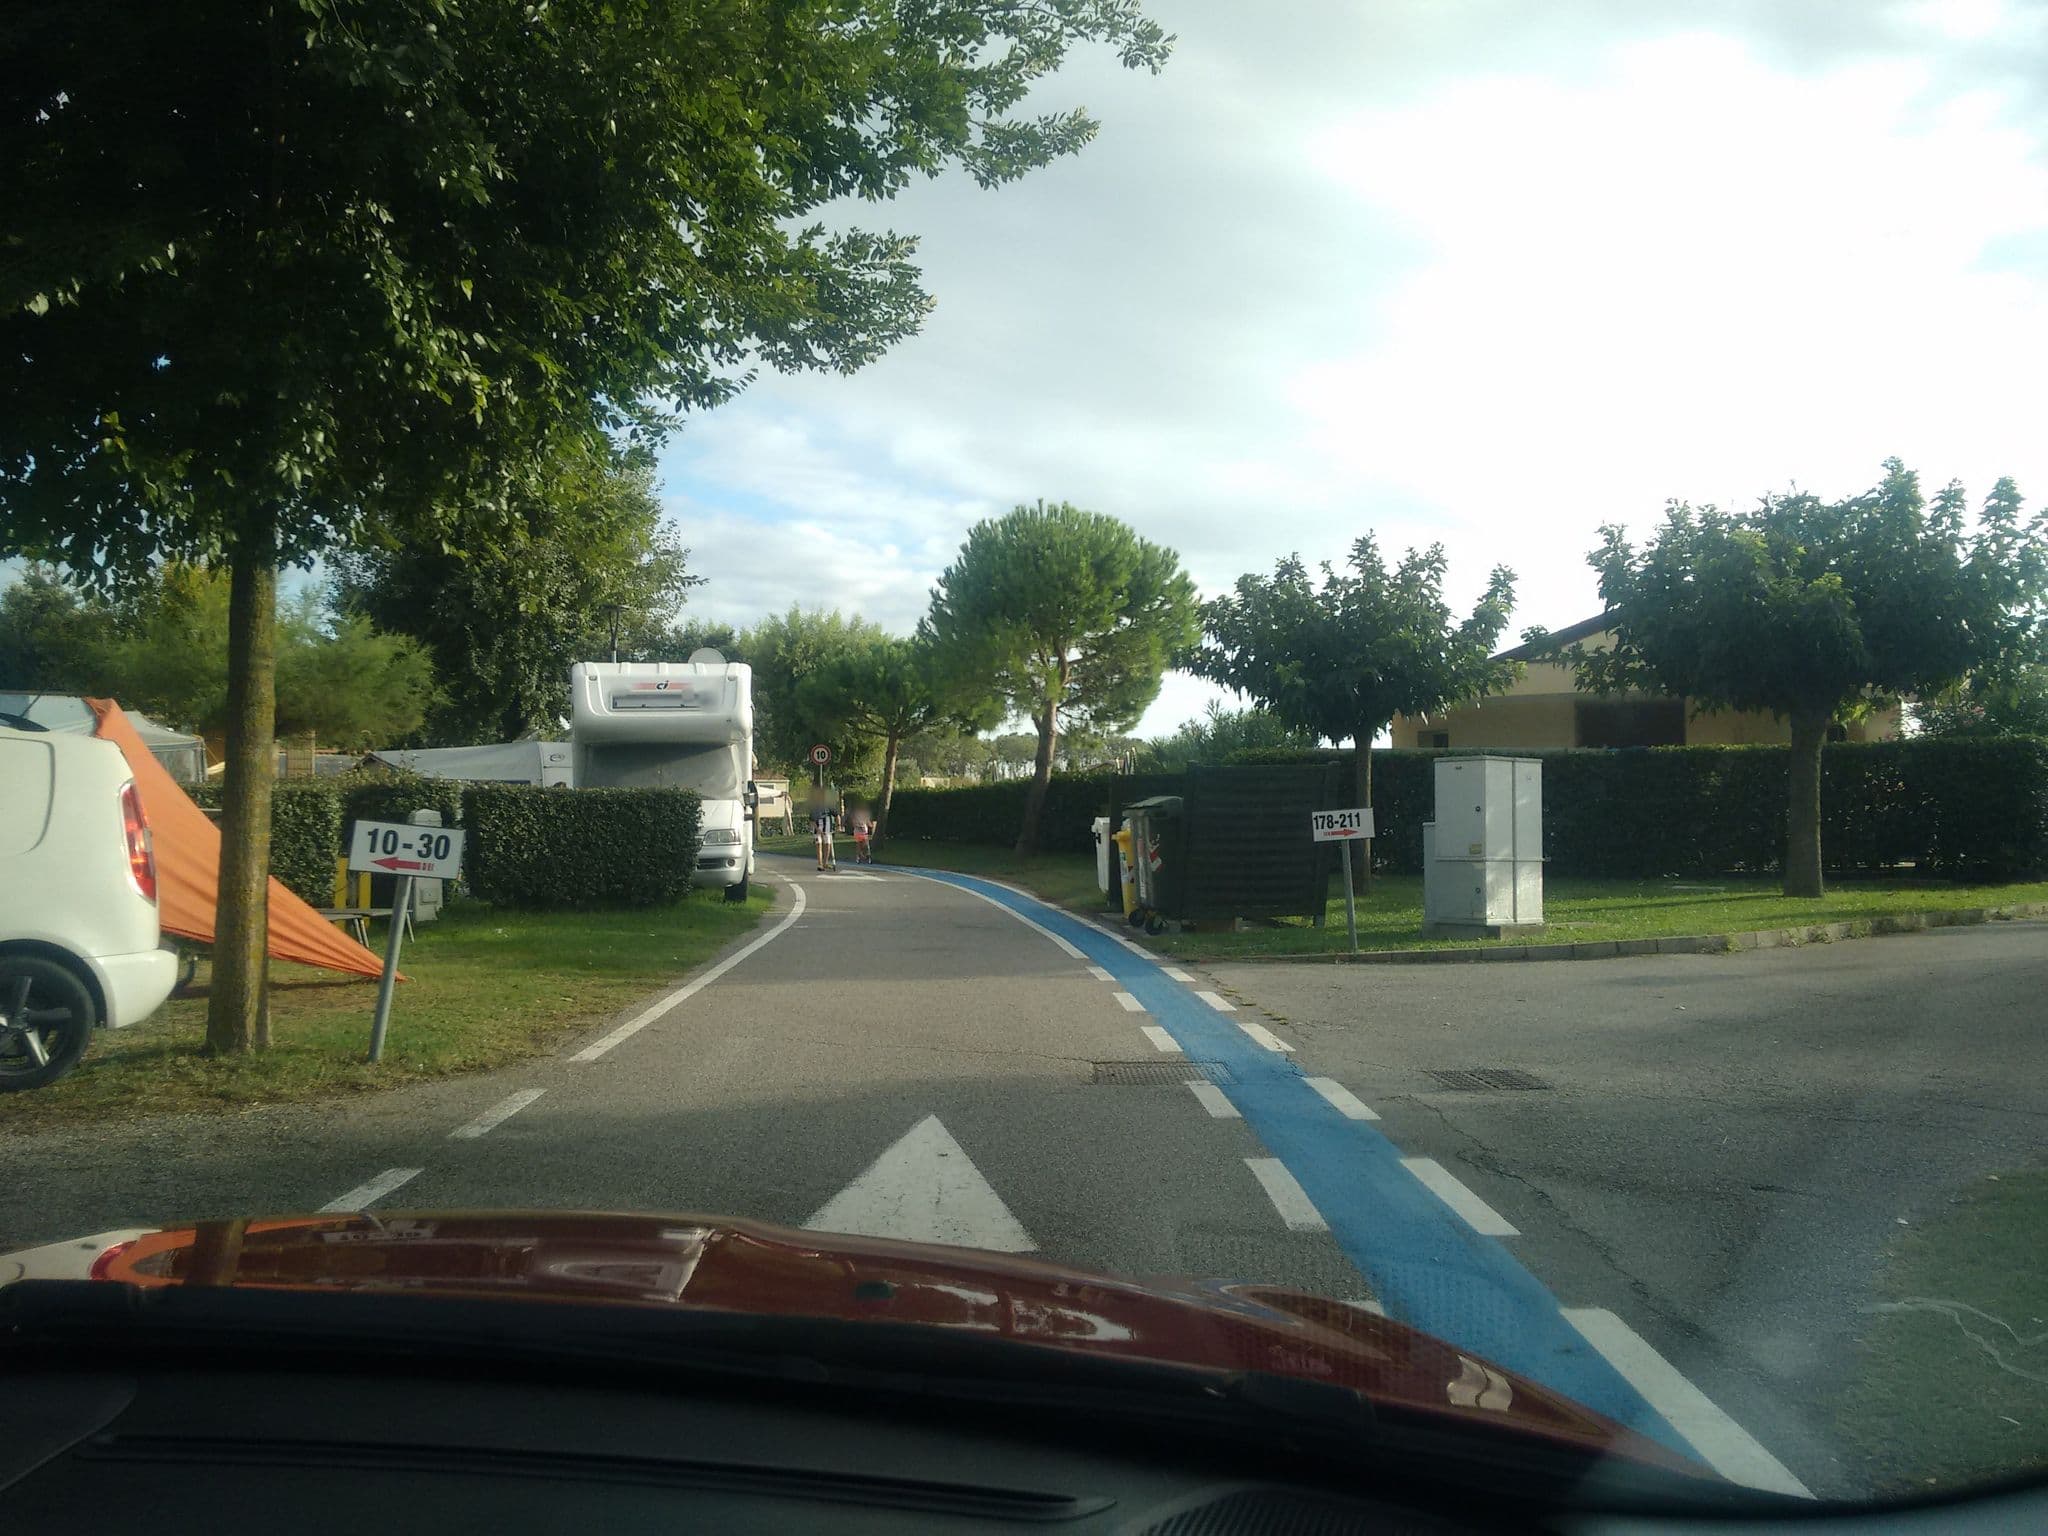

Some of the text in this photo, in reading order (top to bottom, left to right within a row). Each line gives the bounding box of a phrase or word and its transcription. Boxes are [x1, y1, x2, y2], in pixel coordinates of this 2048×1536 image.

[816, 750, 826, 760] 10
[1313, 812, 1361, 830] 178-211
[367, 828, 451, 860] 10-30
